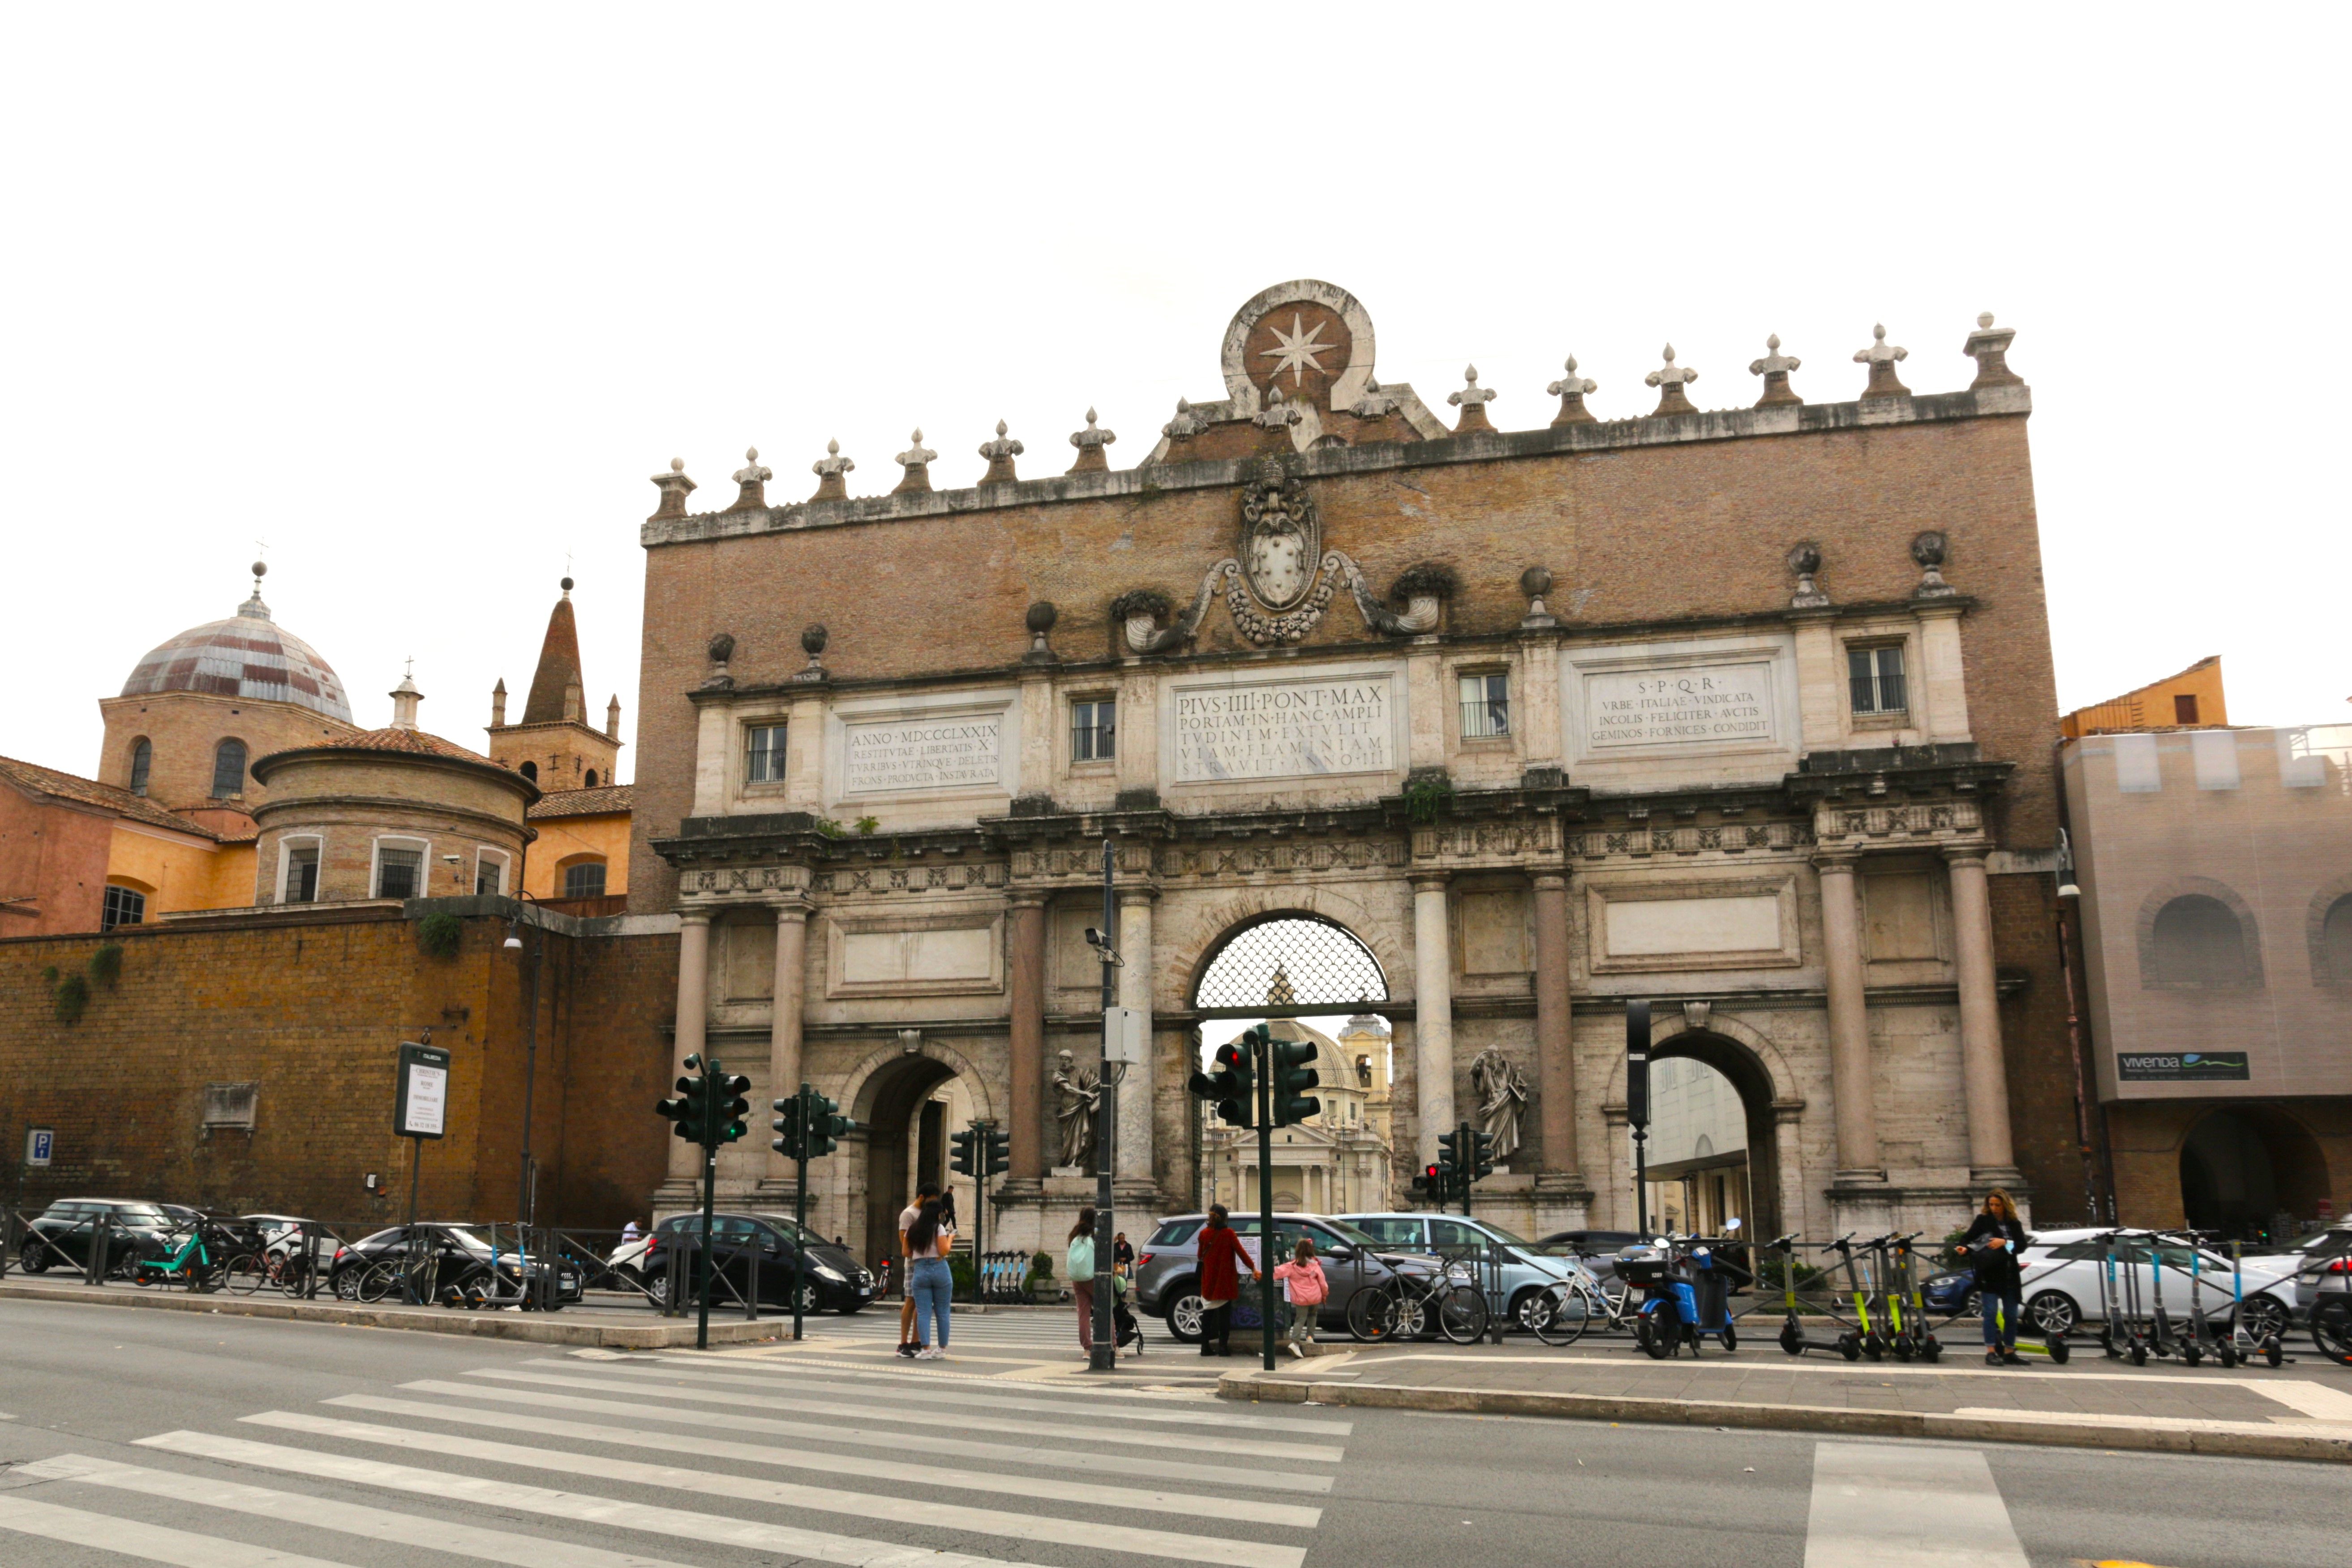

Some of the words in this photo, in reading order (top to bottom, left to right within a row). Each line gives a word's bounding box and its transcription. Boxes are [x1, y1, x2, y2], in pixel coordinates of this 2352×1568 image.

[1180, 697, 1220, 715] PIVS
[1229, 692, 1255, 712] IIII
[1262, 690, 1324, 709] PONT
[1331, 686, 1382, 704] MAX
[1603, 700, 1633, 710] VRBE
[1641, 697, 1687, 708] ITALIAE
[1695, 693, 1754, 705] VINDICATA
[1180, 715, 1245, 730] PORTAM
[1253, 713, 1269, 725] IN
[1276, 709, 1323, 723] HANC
[1331, 706, 1381, 720] AMPLI
[1600, 714, 1642, 725] INCOLIS
[1651, 710, 1711, 722] FELICITER
[1721, 707, 1759, 718] AVCTIS
[852, 733, 891, 746] ANNO
[901, 725, 997, 743] MDCCCLXXIX
[1181, 728, 1270, 744] TVDINEM
[1283, 722, 1370, 739] EXTVLIT
[1592, 729, 1642, 740] GEMINOS
[1650, 725, 1706, 737] FORNICES
[1714, 721, 1768, 733] CONDIDIT
[854, 747, 914, 759] RESTITVTAE
[921, 743, 972, 755] LIBERTATIS
[1182, 745, 1236, 759] VIAM
[1248, 737, 1381, 756] FLAMINIAM
[850, 762, 896, 773] TVRRIBVS
[959, 755, 998, 765] DELETIS
[1184, 759, 1275, 774] STRAVIT
[1292, 754, 1352, 769] ANNO
[1363, 751, 1383, 765] III
[852, 775, 882, 786] FRONS
[888, 772, 934, 783] PRODVCTA
[39, 1135, 47, 1148] P
